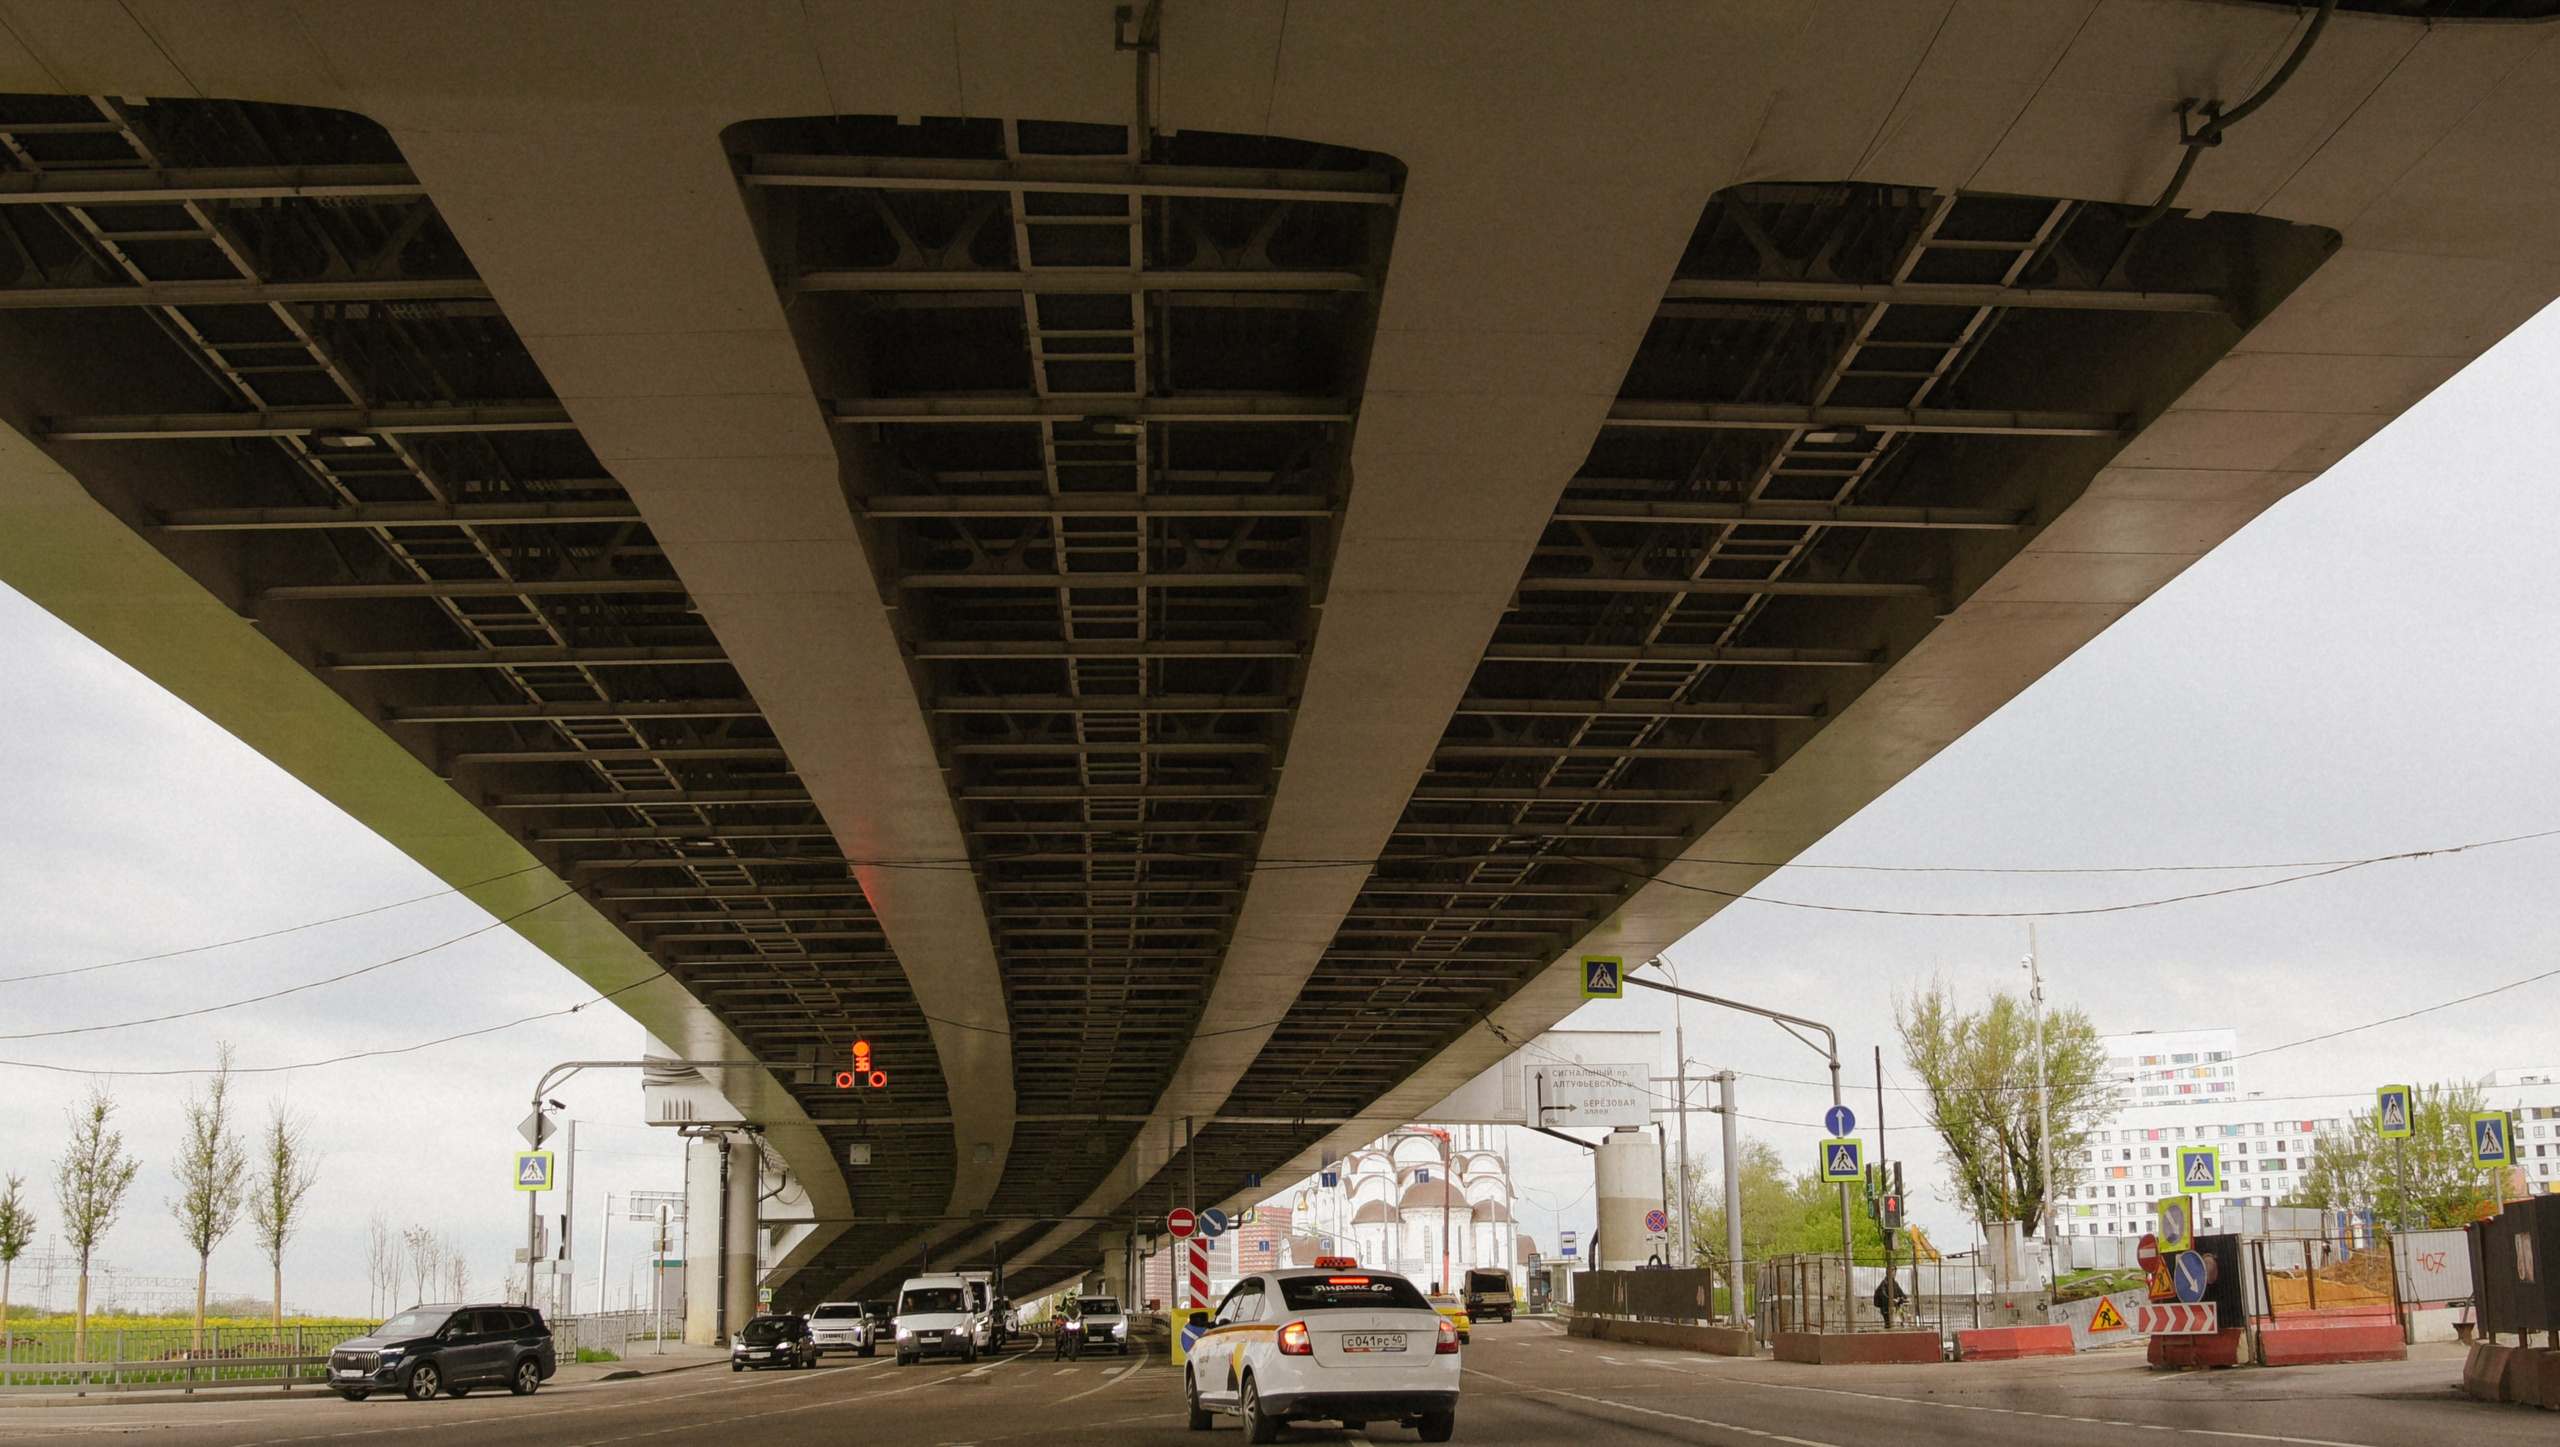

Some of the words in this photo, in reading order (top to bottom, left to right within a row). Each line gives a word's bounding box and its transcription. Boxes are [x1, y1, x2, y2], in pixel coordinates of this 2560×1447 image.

[855, 1057, 870, 1071] 36
[1552, 1067, 1613, 1077] СИГНАЛЬНЫЙ
[1617, 1070, 1629, 1078] пр.
[1553, 1080, 1623, 1088] АЛТУФЬЕВСКОЕ
[1584, 1098, 1636, 1107] БЕРЁЗОВАЯ
[2416, 1247, 2446, 1274] 407
